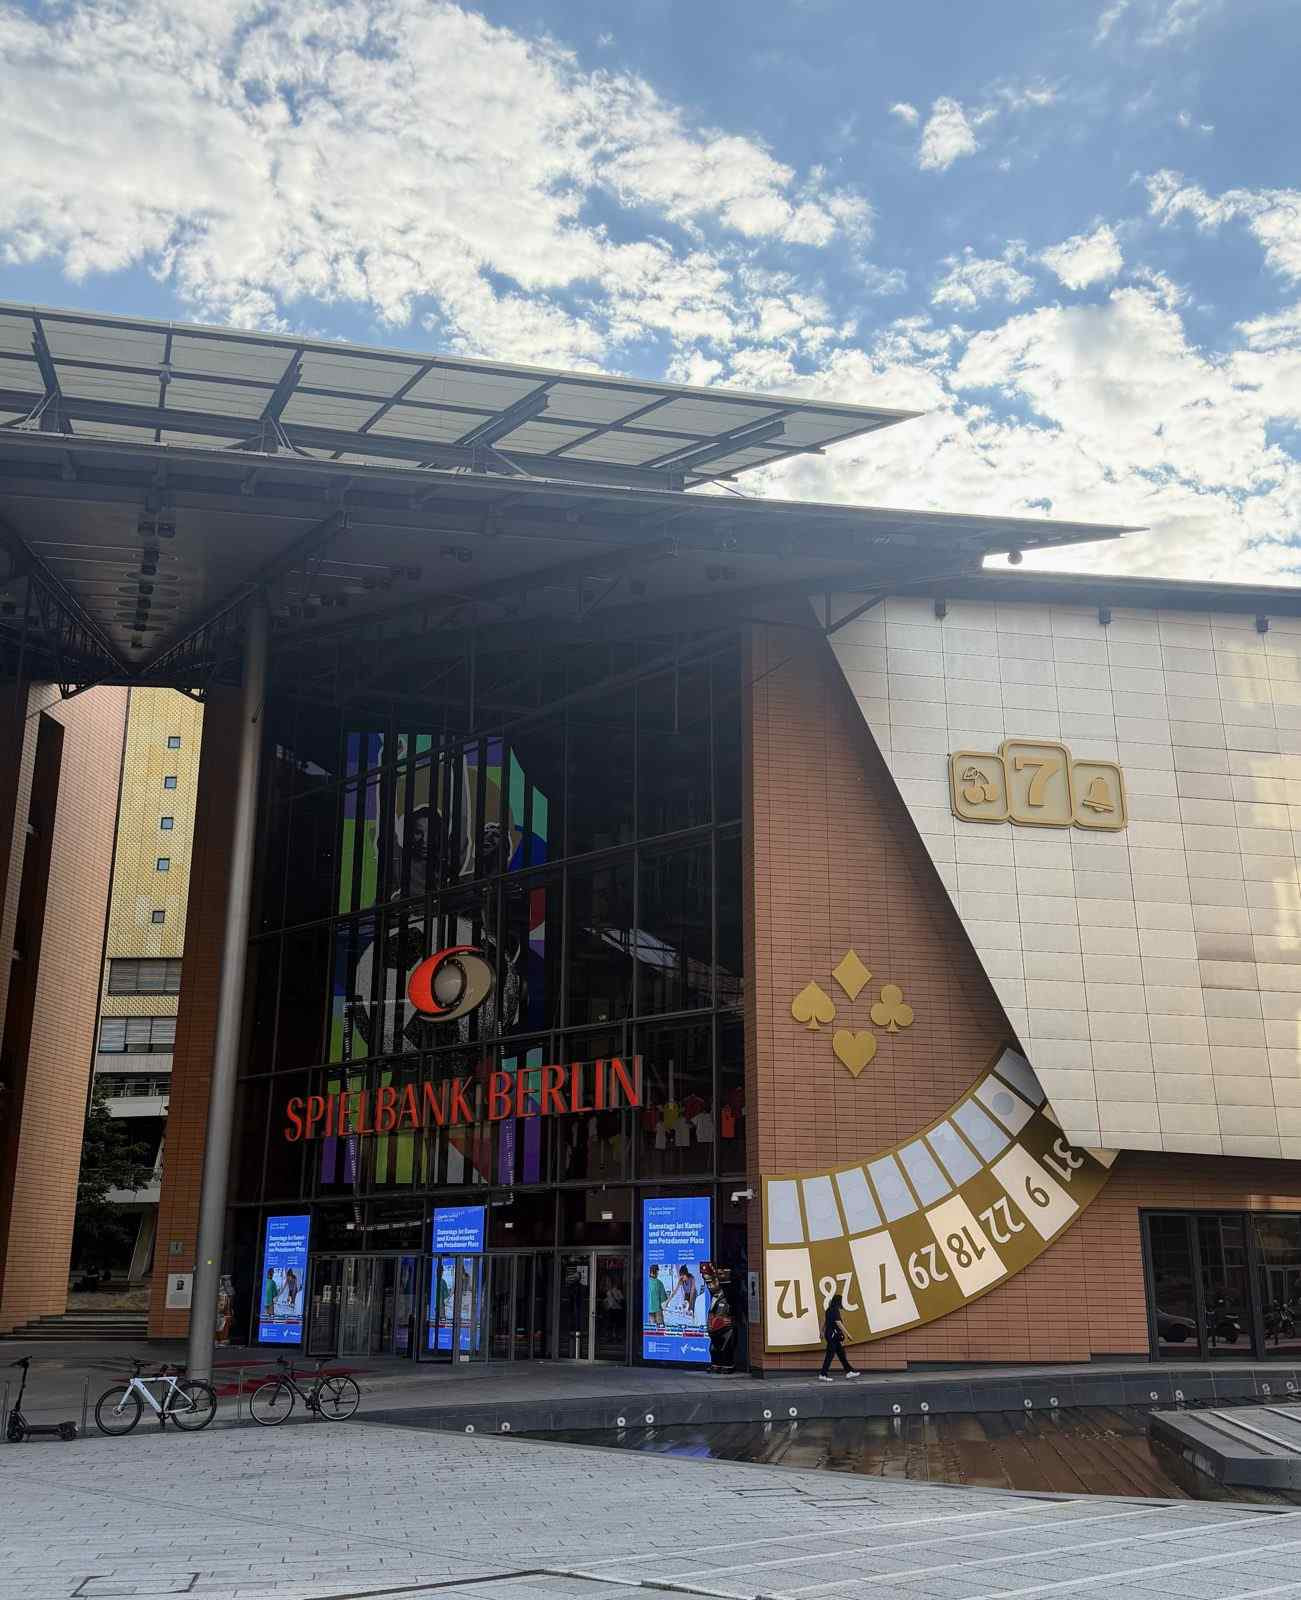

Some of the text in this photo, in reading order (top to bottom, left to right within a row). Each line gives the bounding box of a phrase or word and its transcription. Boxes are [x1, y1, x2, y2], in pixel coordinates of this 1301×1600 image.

[1014, 756, 1059, 809] 7
[285, 1055, 643, 1142] SPIELBANK BERLIN
[1042, 1138, 1085, 1182] 31
[979, 1196, 1026, 1244] 22
[908, 1243, 949, 1290] 29
[946, 1226, 986, 1269] 18
[774, 1279, 809, 1319] 12
[879, 1263, 897, 1304] 7
